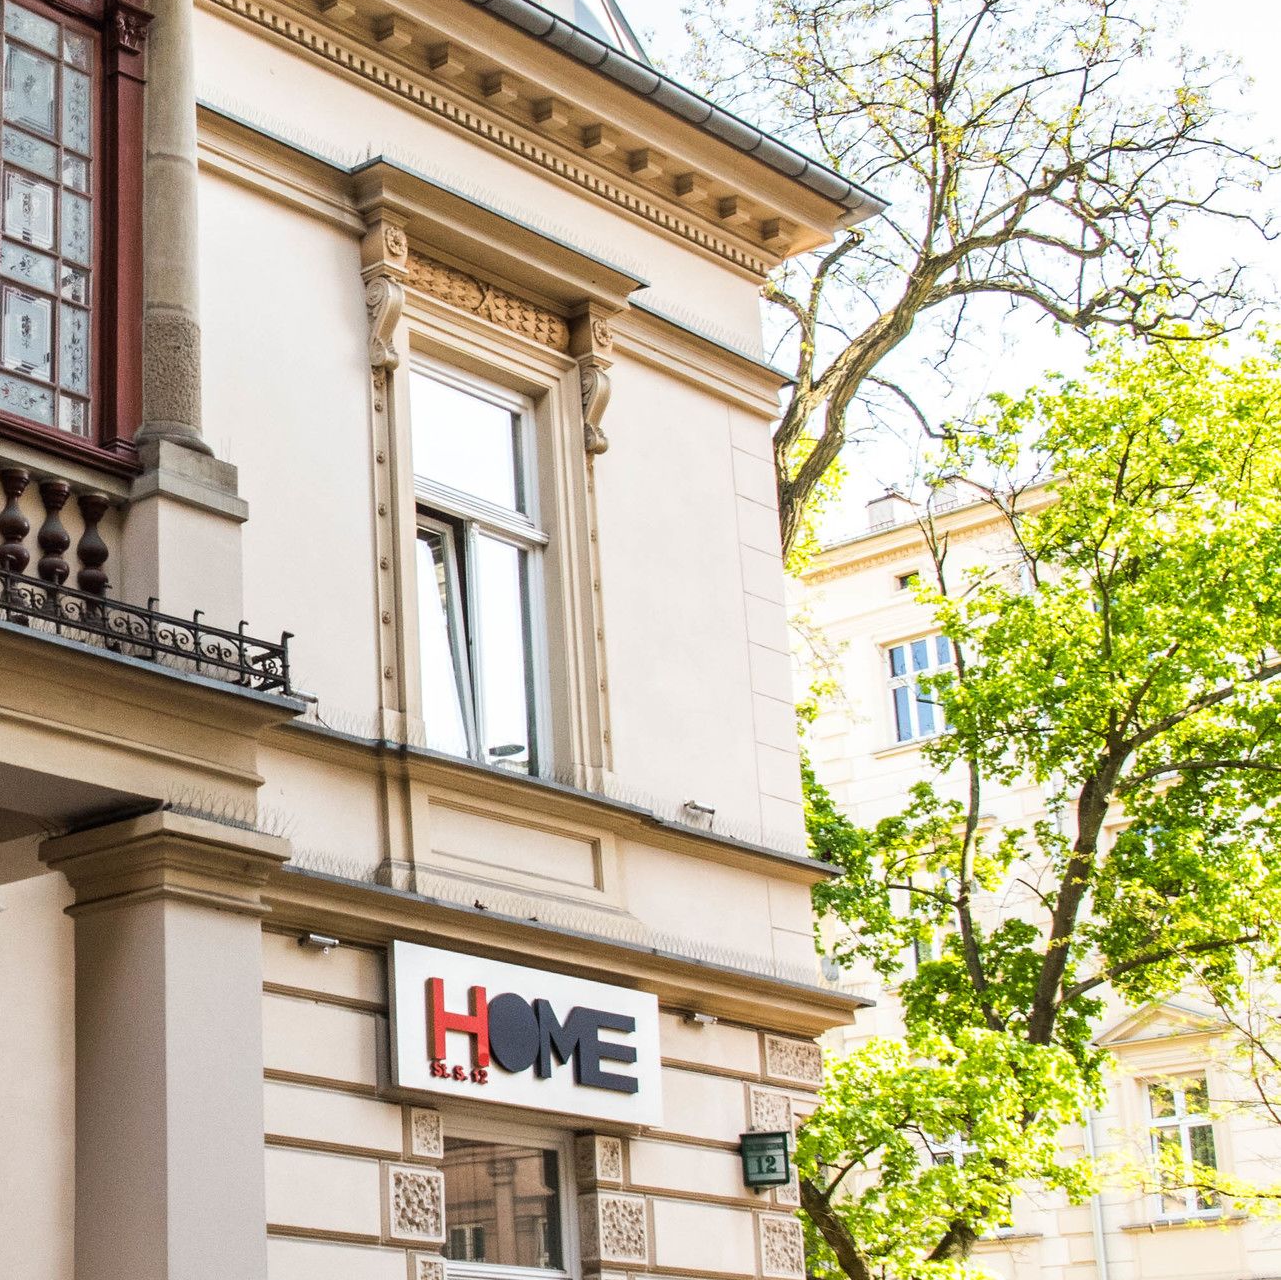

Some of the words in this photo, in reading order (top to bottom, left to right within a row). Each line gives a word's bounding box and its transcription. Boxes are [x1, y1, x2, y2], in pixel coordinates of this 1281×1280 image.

[424, 976, 639, 1095] HOME
[470, 1068, 488, 1085] 12
[756, 1155, 777, 1174] 12
